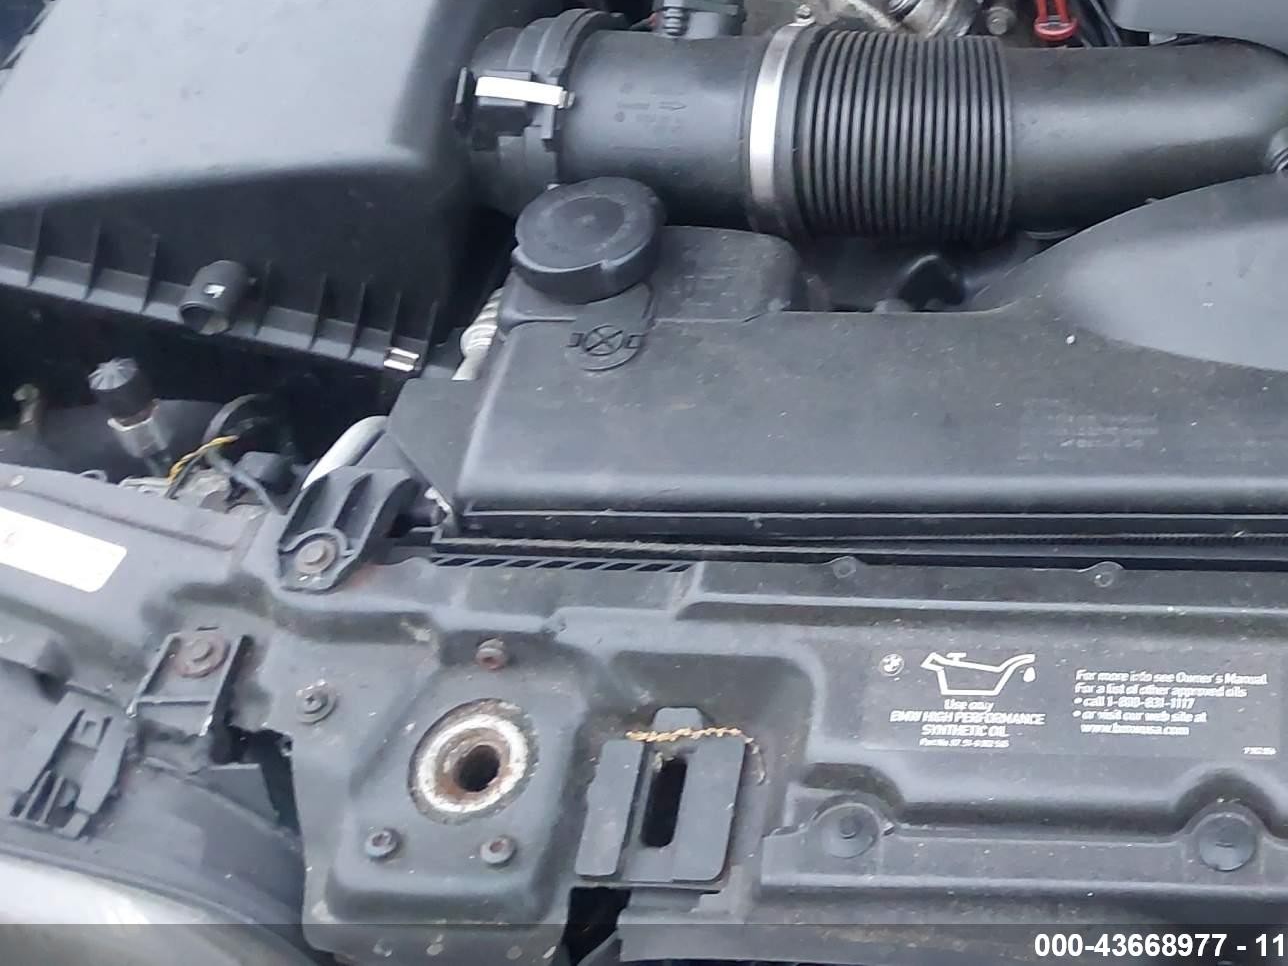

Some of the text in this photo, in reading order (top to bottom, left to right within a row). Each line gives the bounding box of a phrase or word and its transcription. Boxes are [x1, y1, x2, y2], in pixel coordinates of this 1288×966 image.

[1075, 669, 1097, 681] For
[1098, 672, 1129, 682] more
[1153, 673, 1175, 683] see
[1176, 672, 1223, 684] Owner's
[1224, 673, 1267, 685] Manual
[1074, 682, 1248, 698] For a list of other approved oils
[1083, 695, 1105, 707] call
[922, 711, 953, 723] HIGH
[954, 711, 1046, 725] PERFORMANCE
[1082, 708, 1207, 723] or visit our web site at
[921, 723, 1010, 738] SYNTHETIC OIL
